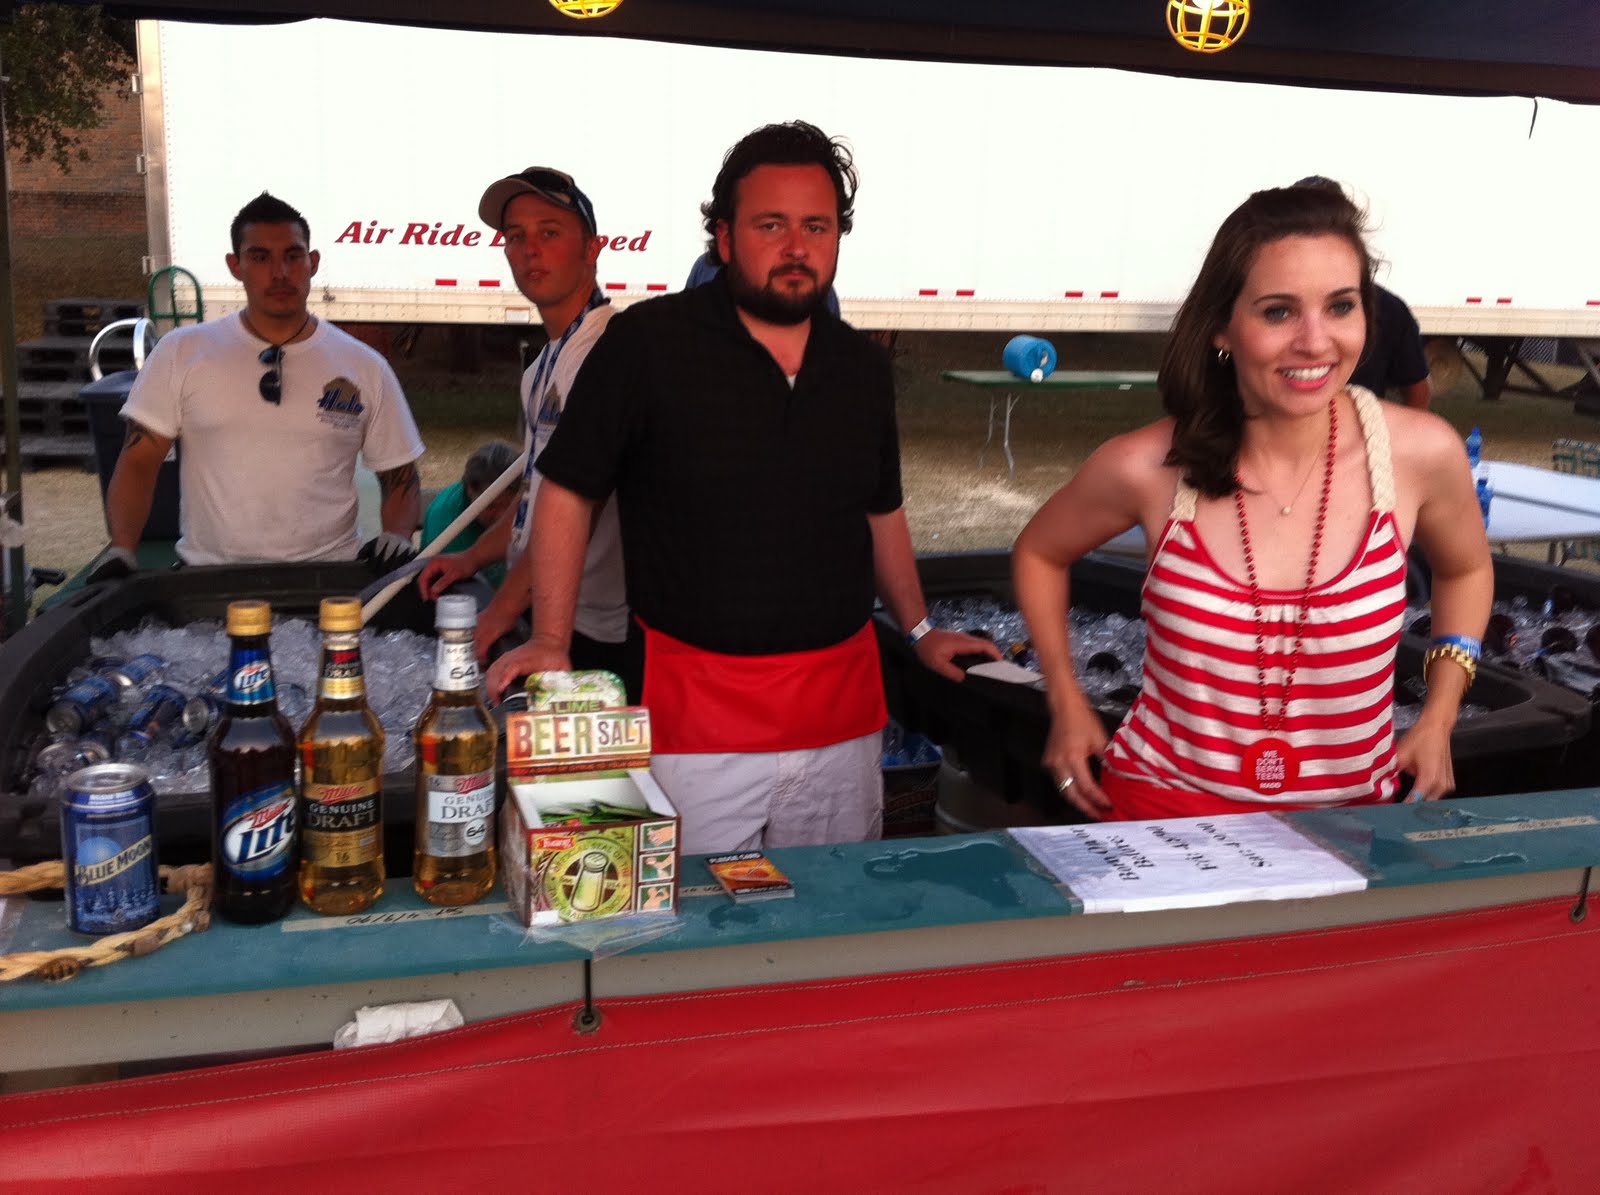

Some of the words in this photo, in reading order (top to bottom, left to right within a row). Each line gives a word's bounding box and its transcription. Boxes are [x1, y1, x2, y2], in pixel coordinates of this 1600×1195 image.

[335, 220, 393, 244] Air
[399, 222, 481, 247] Ride
[450, 664, 476, 679] 64
[554, 701, 602, 713] LIME
[514, 714, 593, 758] BEER
[598, 718, 647, 746] SALT
[1256, 757, 1285, 766] DON'T
[1262, 750, 1278, 758] WE
[1255, 772, 1286, 780] TEENS
[309, 799, 376, 814] GENUINE
[307, 809, 376, 829] DRAFT
[466, 824, 486, 838] 64
[75, 860, 116, 884] BLUE
